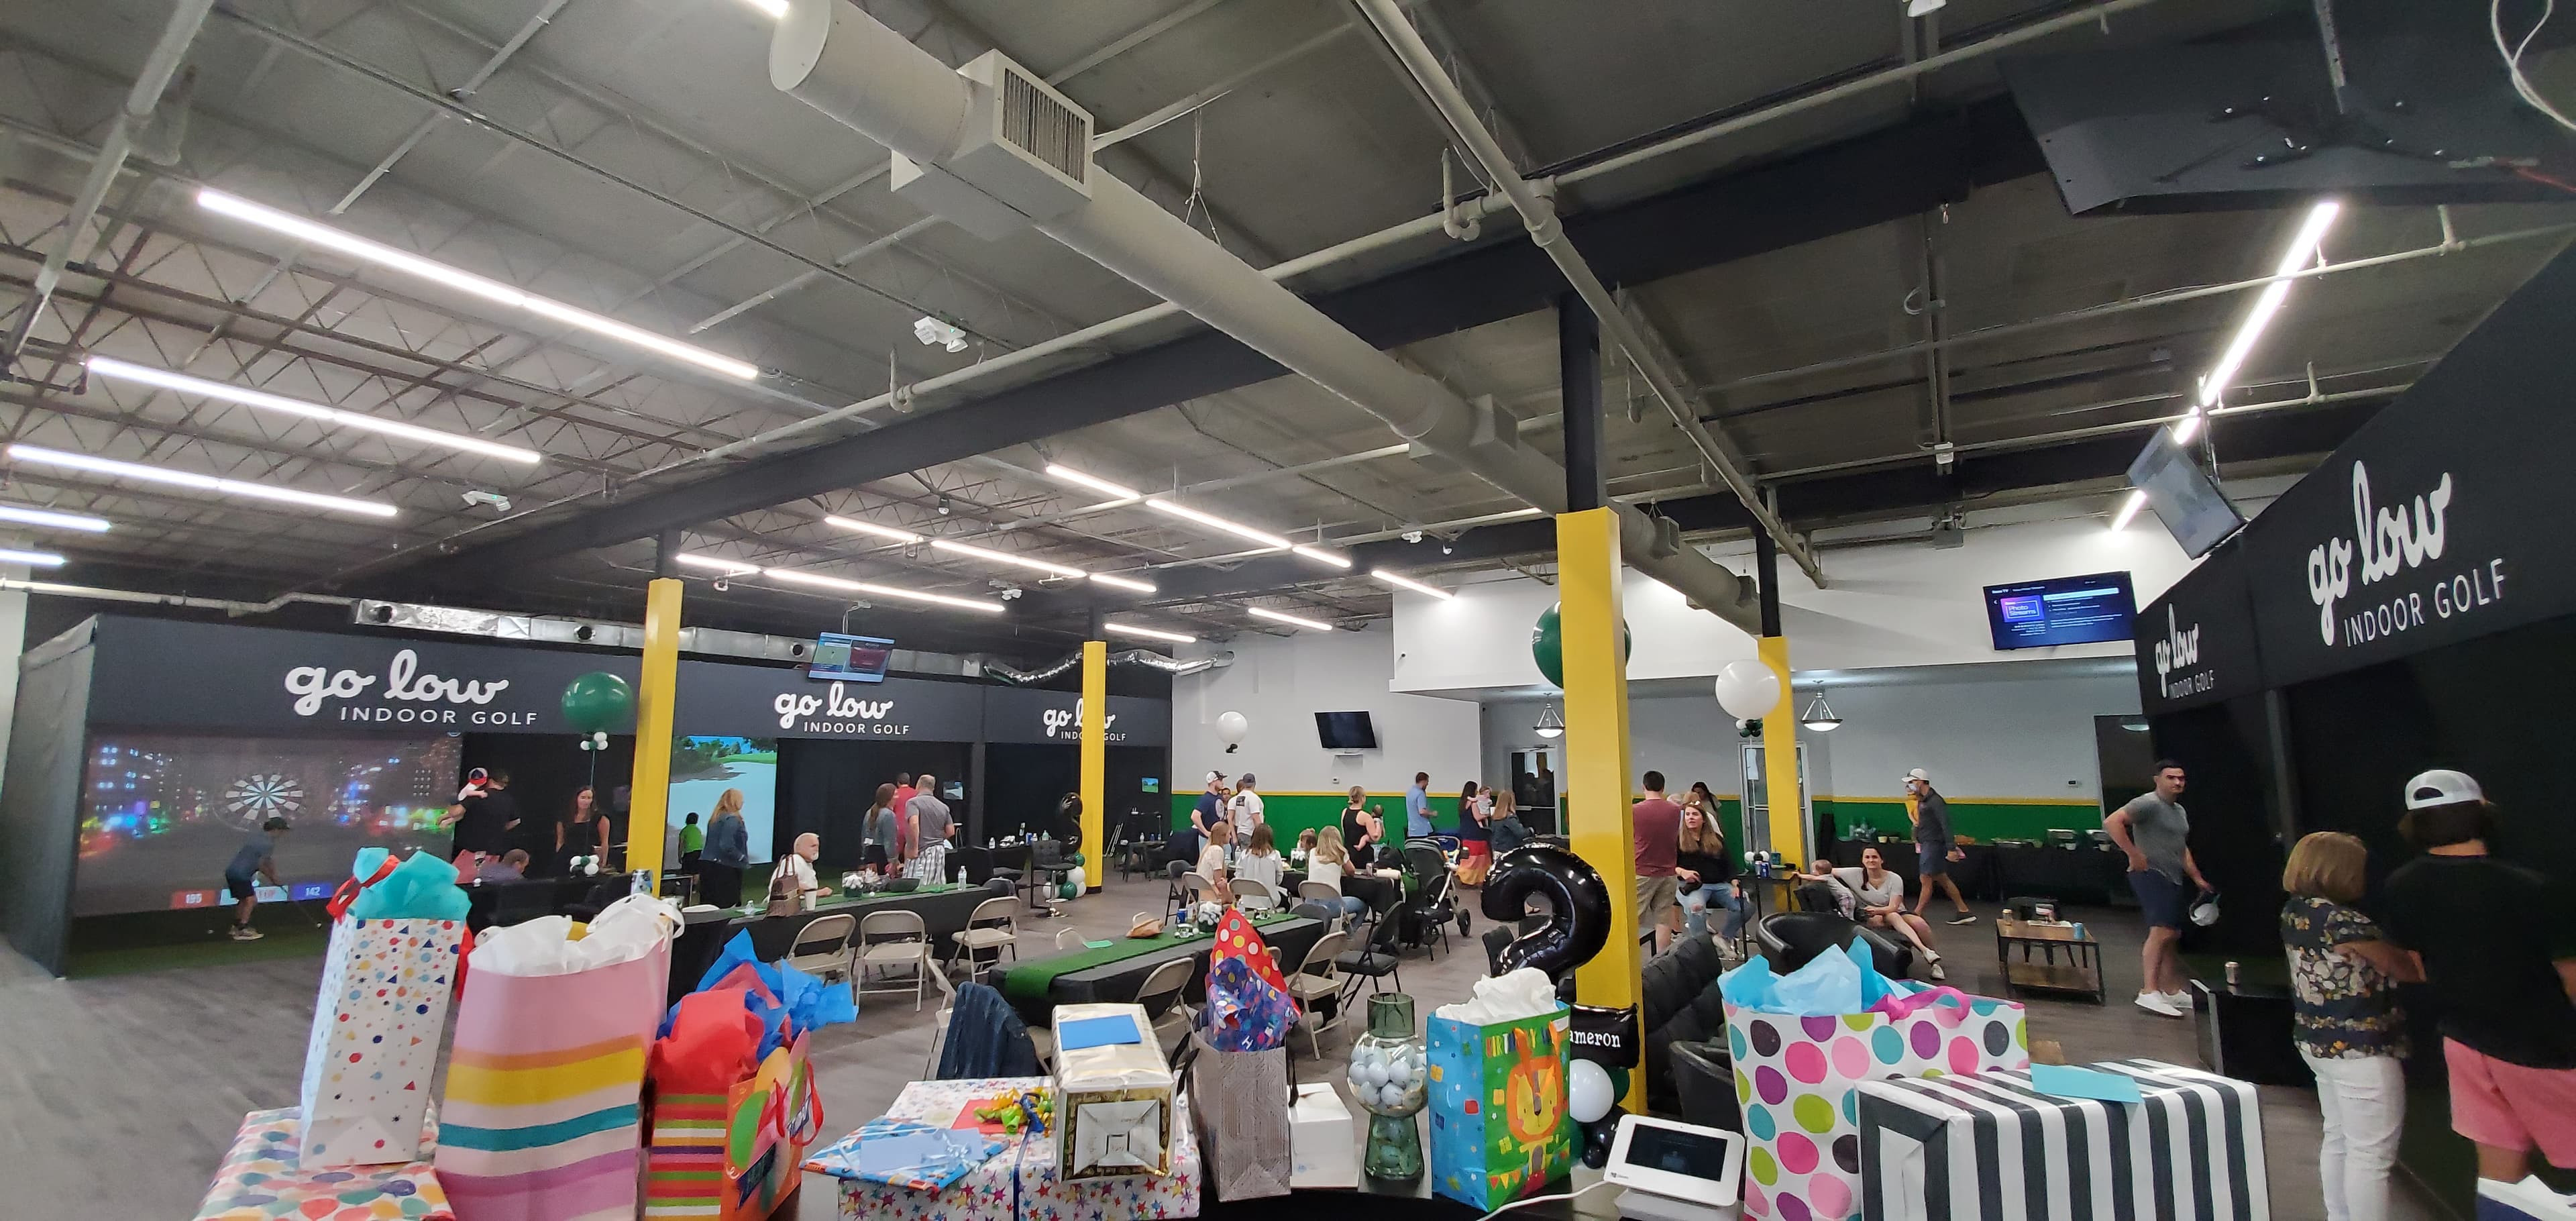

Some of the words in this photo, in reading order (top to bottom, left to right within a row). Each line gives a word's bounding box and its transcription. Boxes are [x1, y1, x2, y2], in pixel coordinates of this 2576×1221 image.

[2308, 537, 2351, 646] go
[2353, 460, 2451, 586] low
[2344, 592, 2424, 647] INDOOR
[2434, 558, 2505, 618] GOLF
[2155, 639, 2170, 698] go
[2169, 603, 2199, 669] low
[284, 667, 376, 716] go
[383, 649, 509, 704] low
[2194, 670, 2214, 693] GOLF
[340, 706, 457, 724] INDOOR
[472, 711, 537, 725] GOLF
[774, 693, 822, 729] go
[826, 681, 894, 719] low
[804, 721, 865, 734] INDOOR
[873, 724, 910, 735] GOLF
[1043, 709, 1072, 737] go
[1104, 733, 1126, 741] GOLF
[305, 886, 321, 897] 142
[1570, 1030, 1621, 1048] ameron
